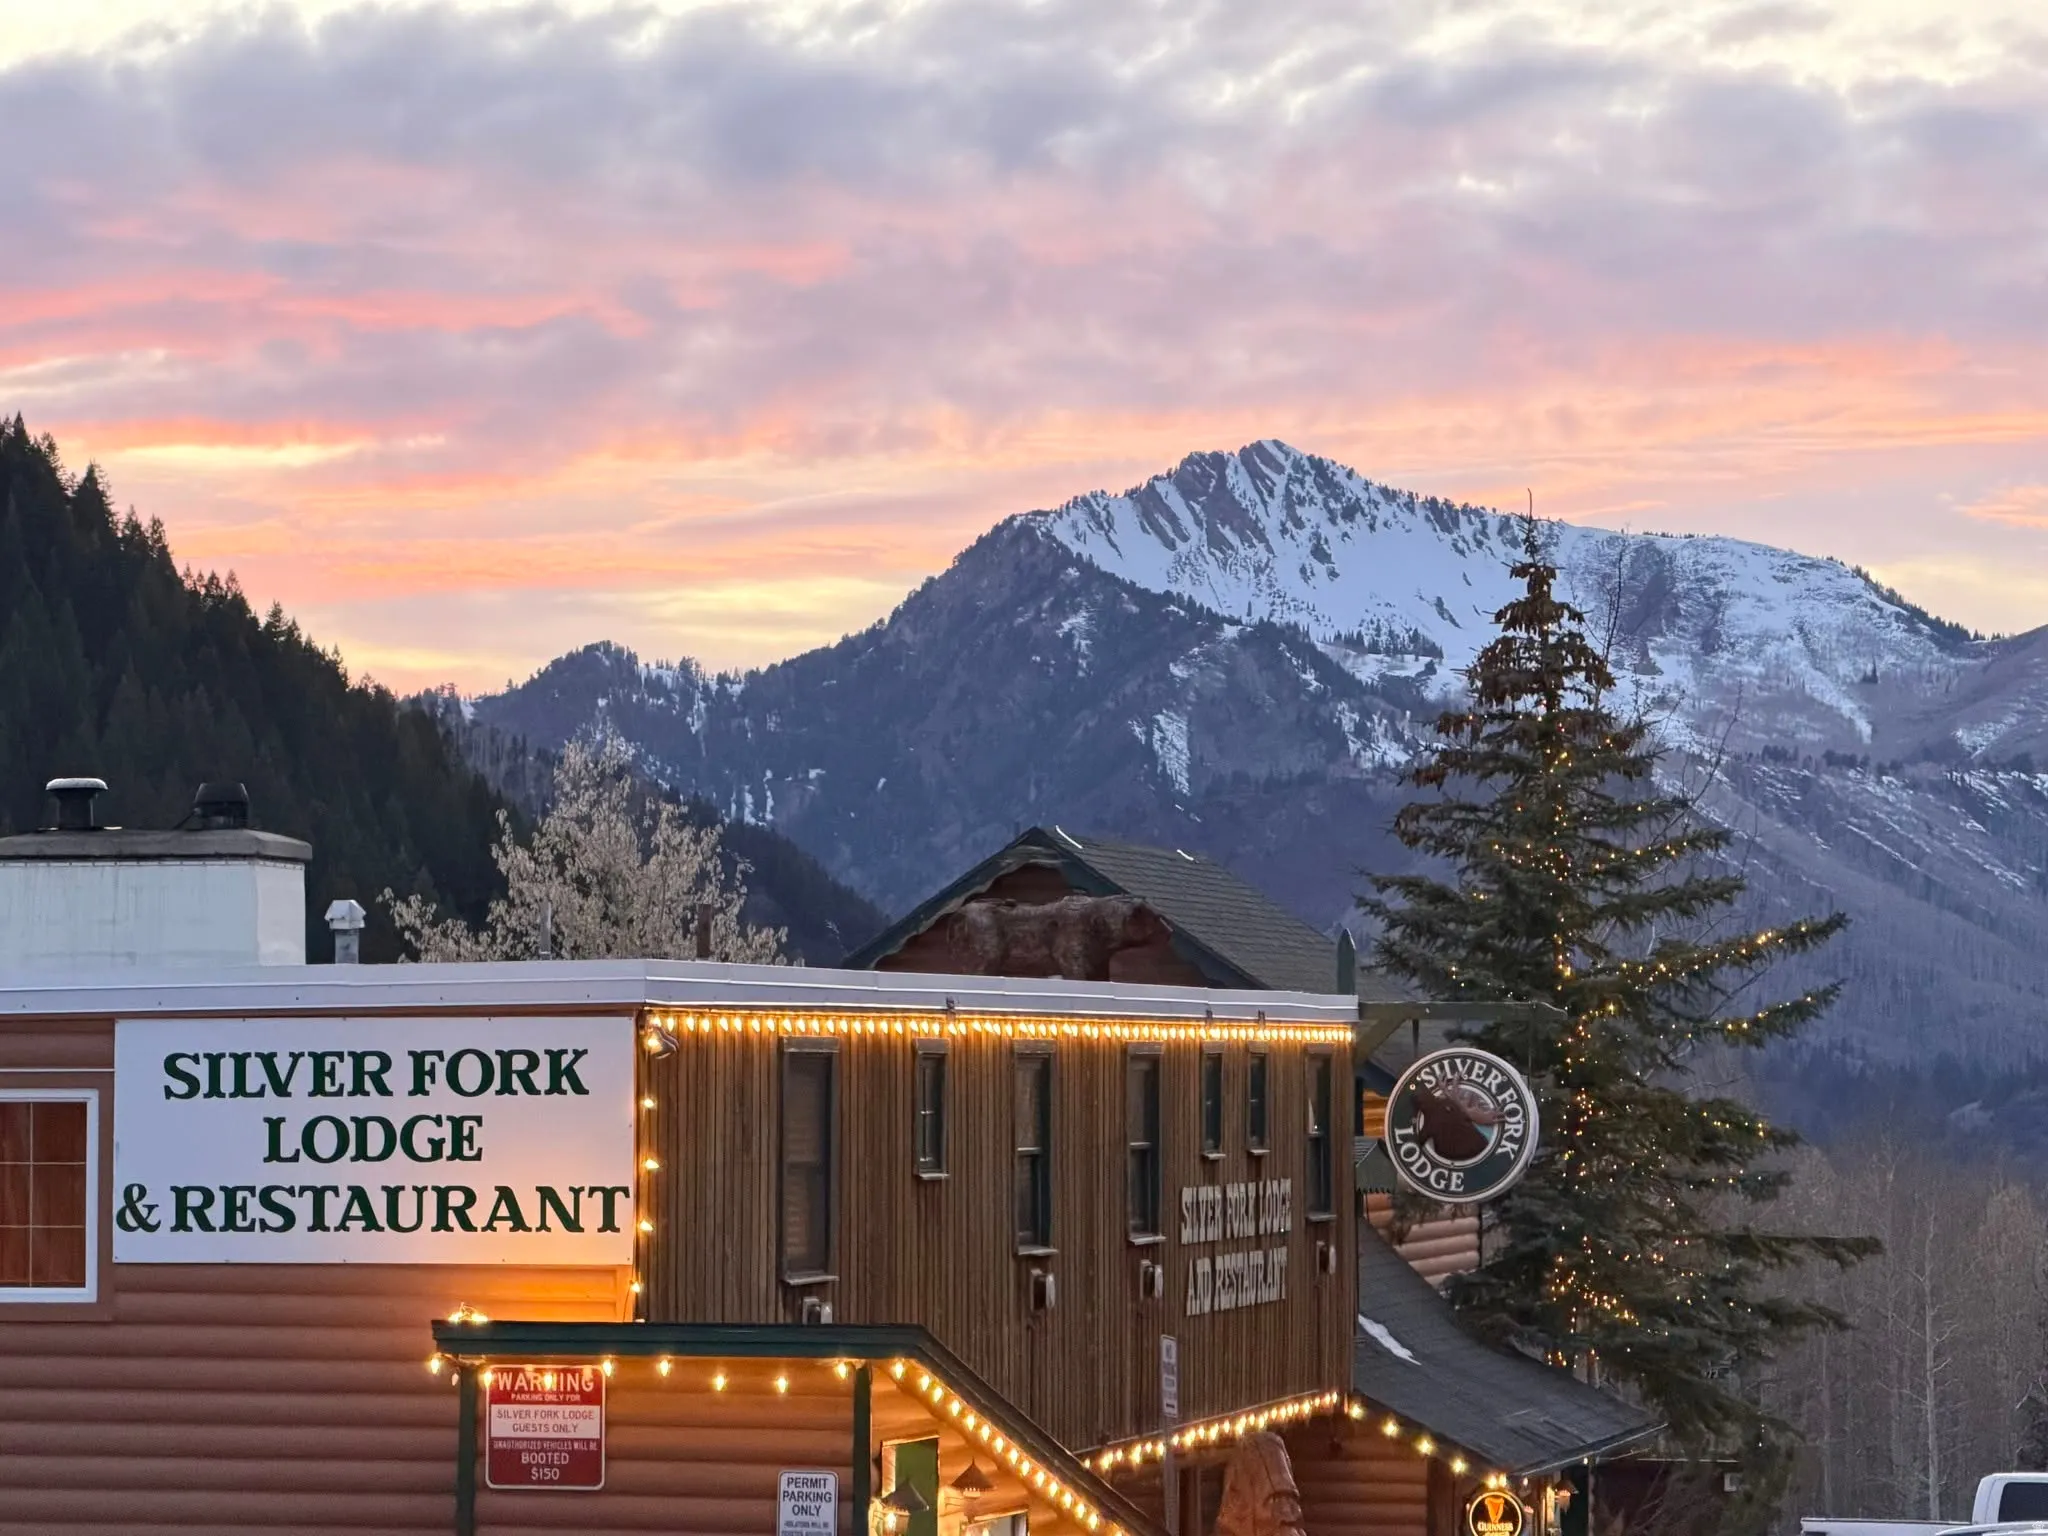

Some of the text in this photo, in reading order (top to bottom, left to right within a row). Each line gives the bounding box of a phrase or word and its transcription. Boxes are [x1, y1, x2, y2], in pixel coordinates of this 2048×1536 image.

[164, 1048, 589, 1100] SILVER FORK
[1420, 1058, 1524, 1161] SILVER FORK
[263, 1115, 483, 1163] LODGE
[1394, 1126, 1465, 1192] LODGE
[115, 1183, 631, 1233] & RESTAURANT
[1181, 1178, 1291, 1245] SILVER FORK LODGE
[1213, 1246, 1288, 1312] RESTAURANT
[511, 1393, 543, 1401] PARKING
[544, 1394, 564, 1402] ONLY
[496, 1410, 595, 1420] SILVER FORK LODGE
[512, 1424, 579, 1433] GUESTS ONLY
[521, 1452, 569, 1465] BOOTED
[531, 1466, 560, 1480] $150
[787, 1477, 829, 1489] PERMIT
[782, 1490, 832, 1503] PARKING
[792, 1504, 821, 1517] ONLY
[1477, 1521, 1513, 1532] GUINNESS
